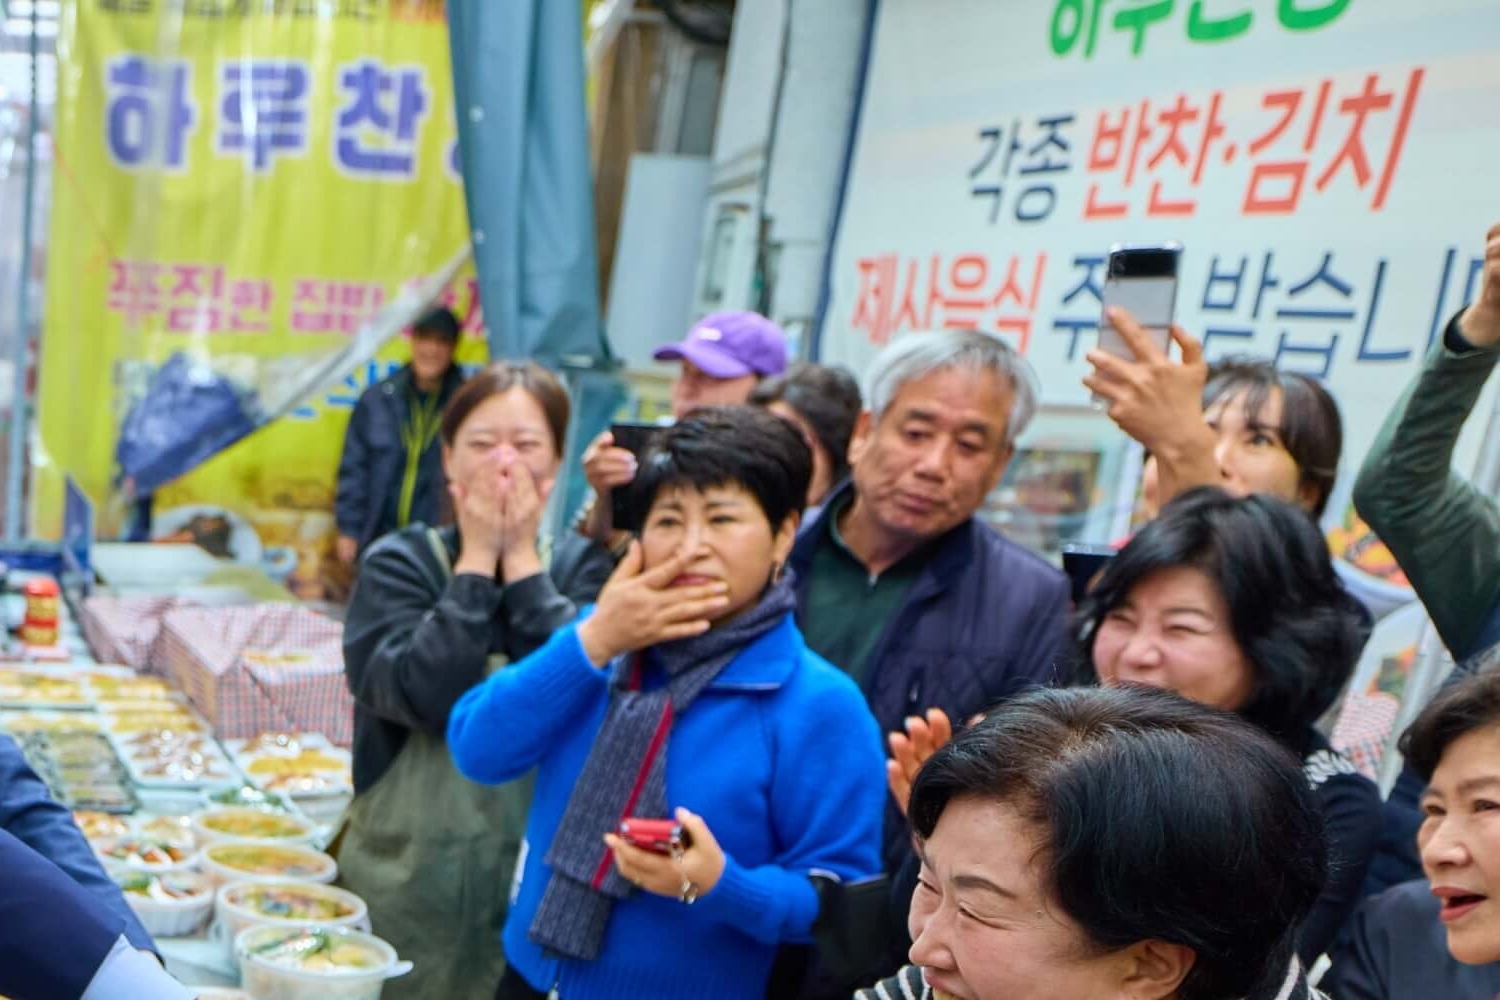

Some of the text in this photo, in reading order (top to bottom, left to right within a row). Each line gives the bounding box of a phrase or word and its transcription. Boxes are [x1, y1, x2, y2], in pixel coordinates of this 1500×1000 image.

[108, 56, 464, 178] 하루찬
[968, 114, 1075, 224] 각종
[851, 252, 1048, 356] 제사음식
[1200, 248, 1484, 378] 받습니
